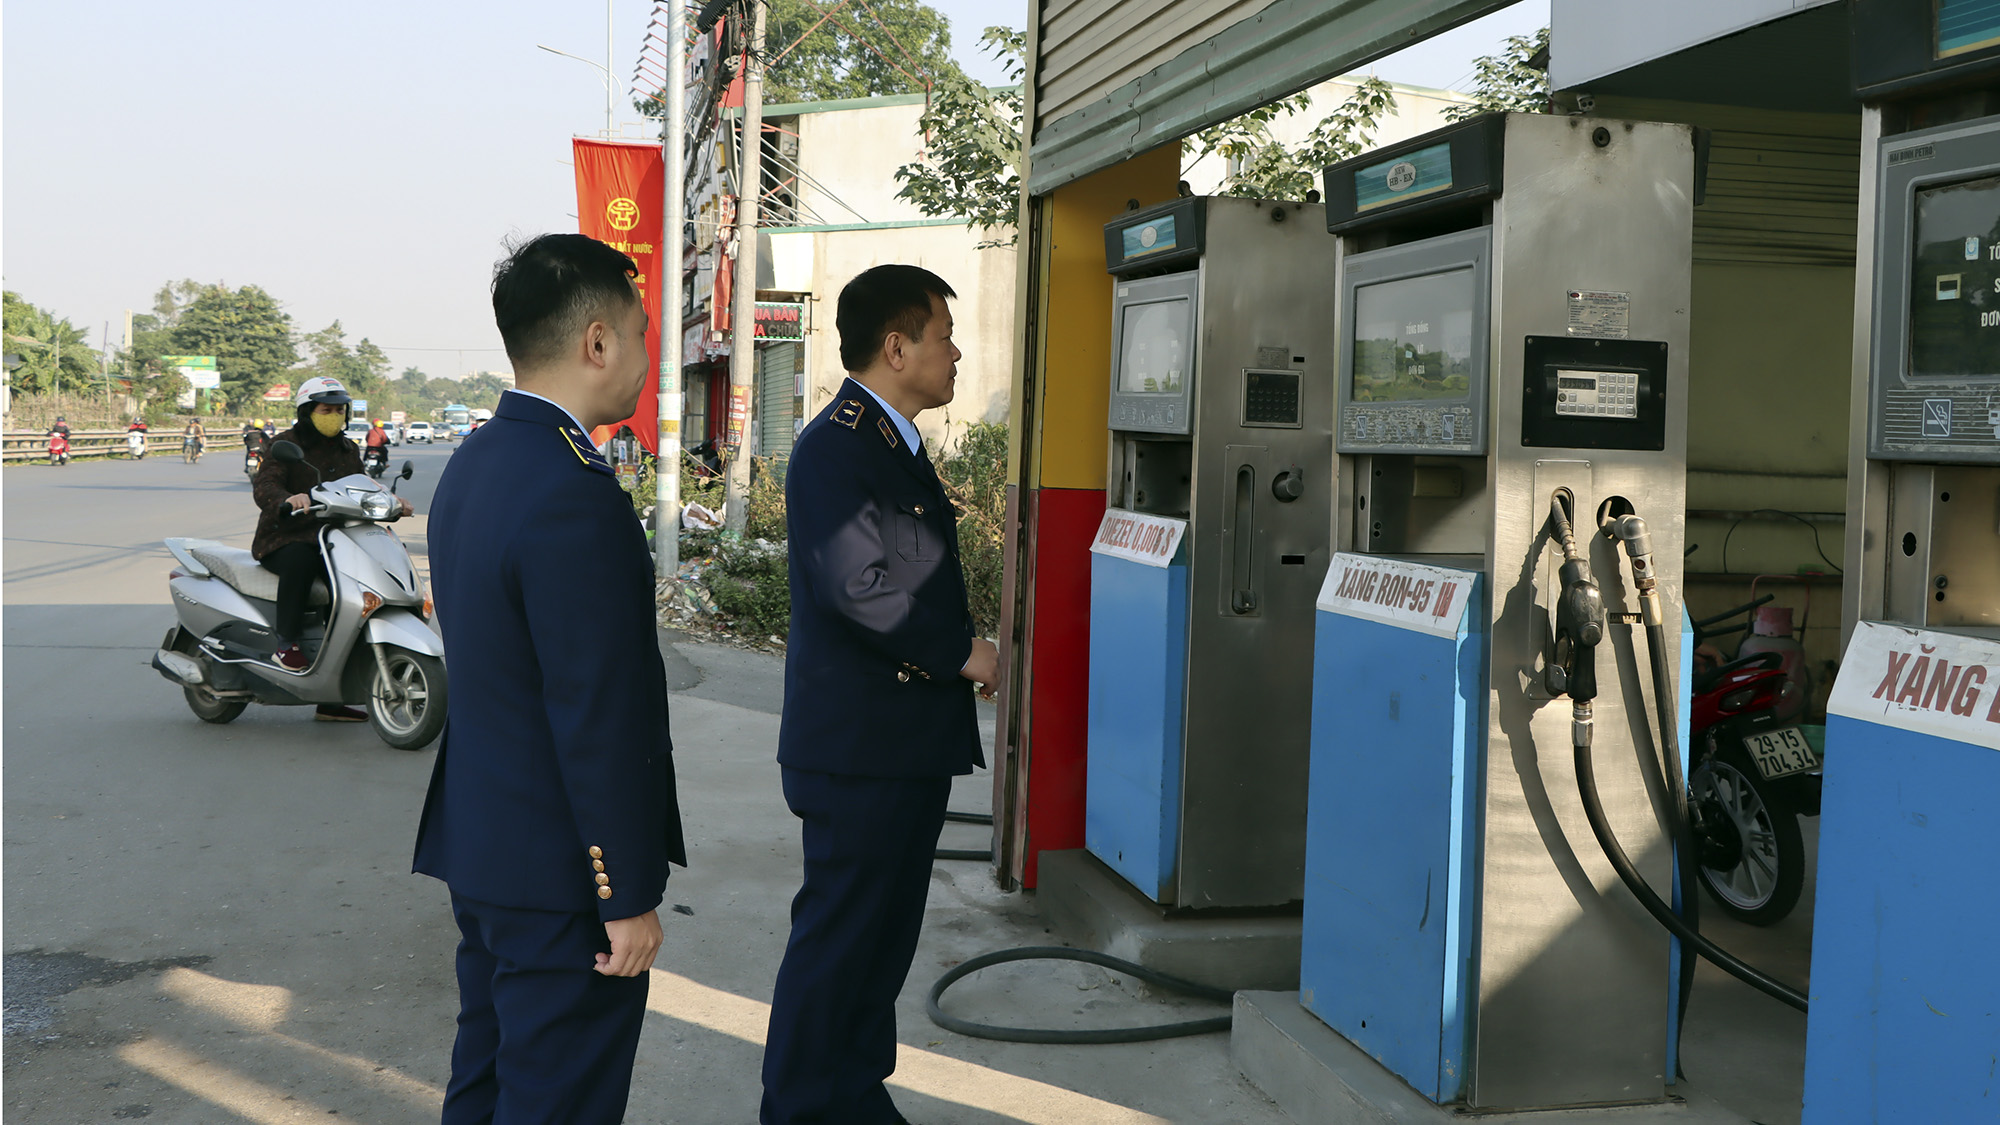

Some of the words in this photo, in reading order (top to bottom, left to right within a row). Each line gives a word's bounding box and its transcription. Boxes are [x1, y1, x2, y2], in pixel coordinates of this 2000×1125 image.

[1388, 177, 1399, 187] HB
[1403, 172, 1414, 183] EX
[1394, 165, 1406, 176] NEW
[754, 308, 772, 321] UA
[1098, 516, 1135, 549] DIEZEL
[1335, 561, 1379, 603] XĂNG
[1374, 573, 1435, 614] RON-95
[1872, 643, 1987, 718] XĂNG
[1754, 730, 1800, 755] 29-Y5
[1758, 748, 1815, 776] 704.34
